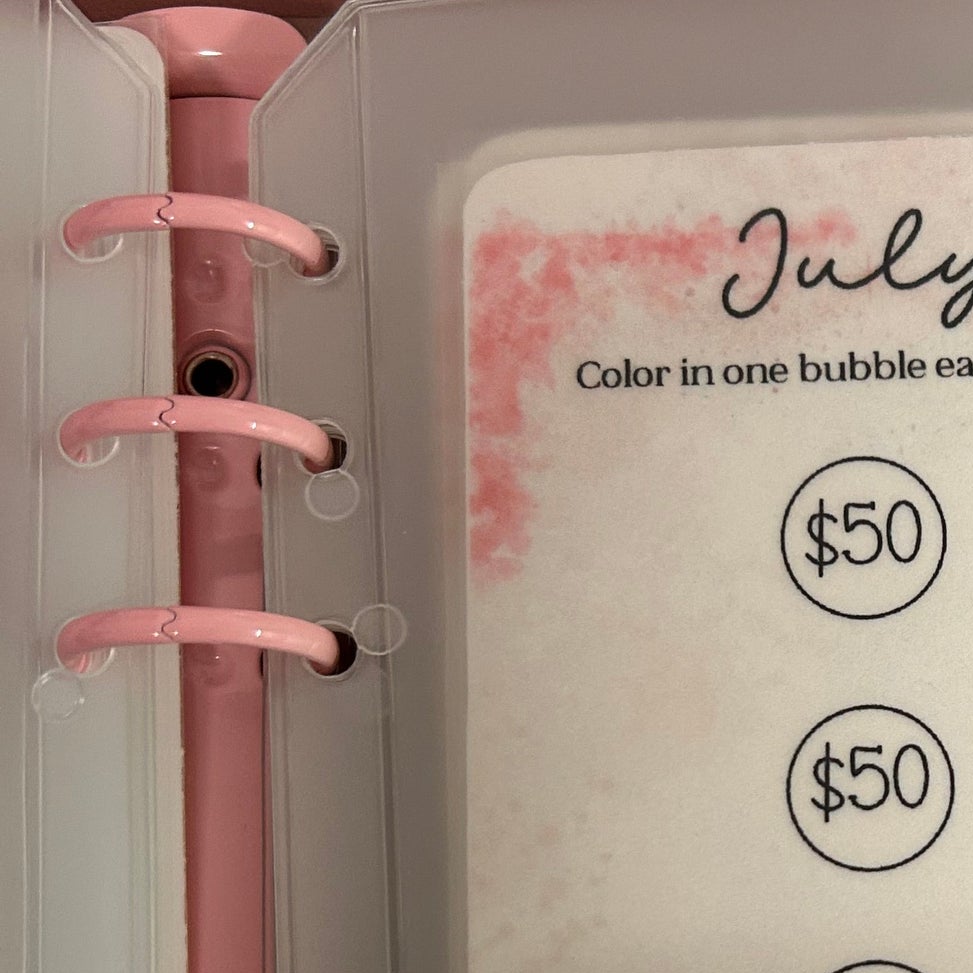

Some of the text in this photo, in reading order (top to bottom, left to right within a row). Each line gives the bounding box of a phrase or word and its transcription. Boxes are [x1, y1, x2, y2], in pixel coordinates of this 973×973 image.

[576, 357, 672, 390] Color
[679, 357, 716, 387] in
[721, 362, 789, 386] one
[798, 350, 927, 383] bubble
[804, 497, 923, 579] $50
[810, 741, 930, 824] $50
